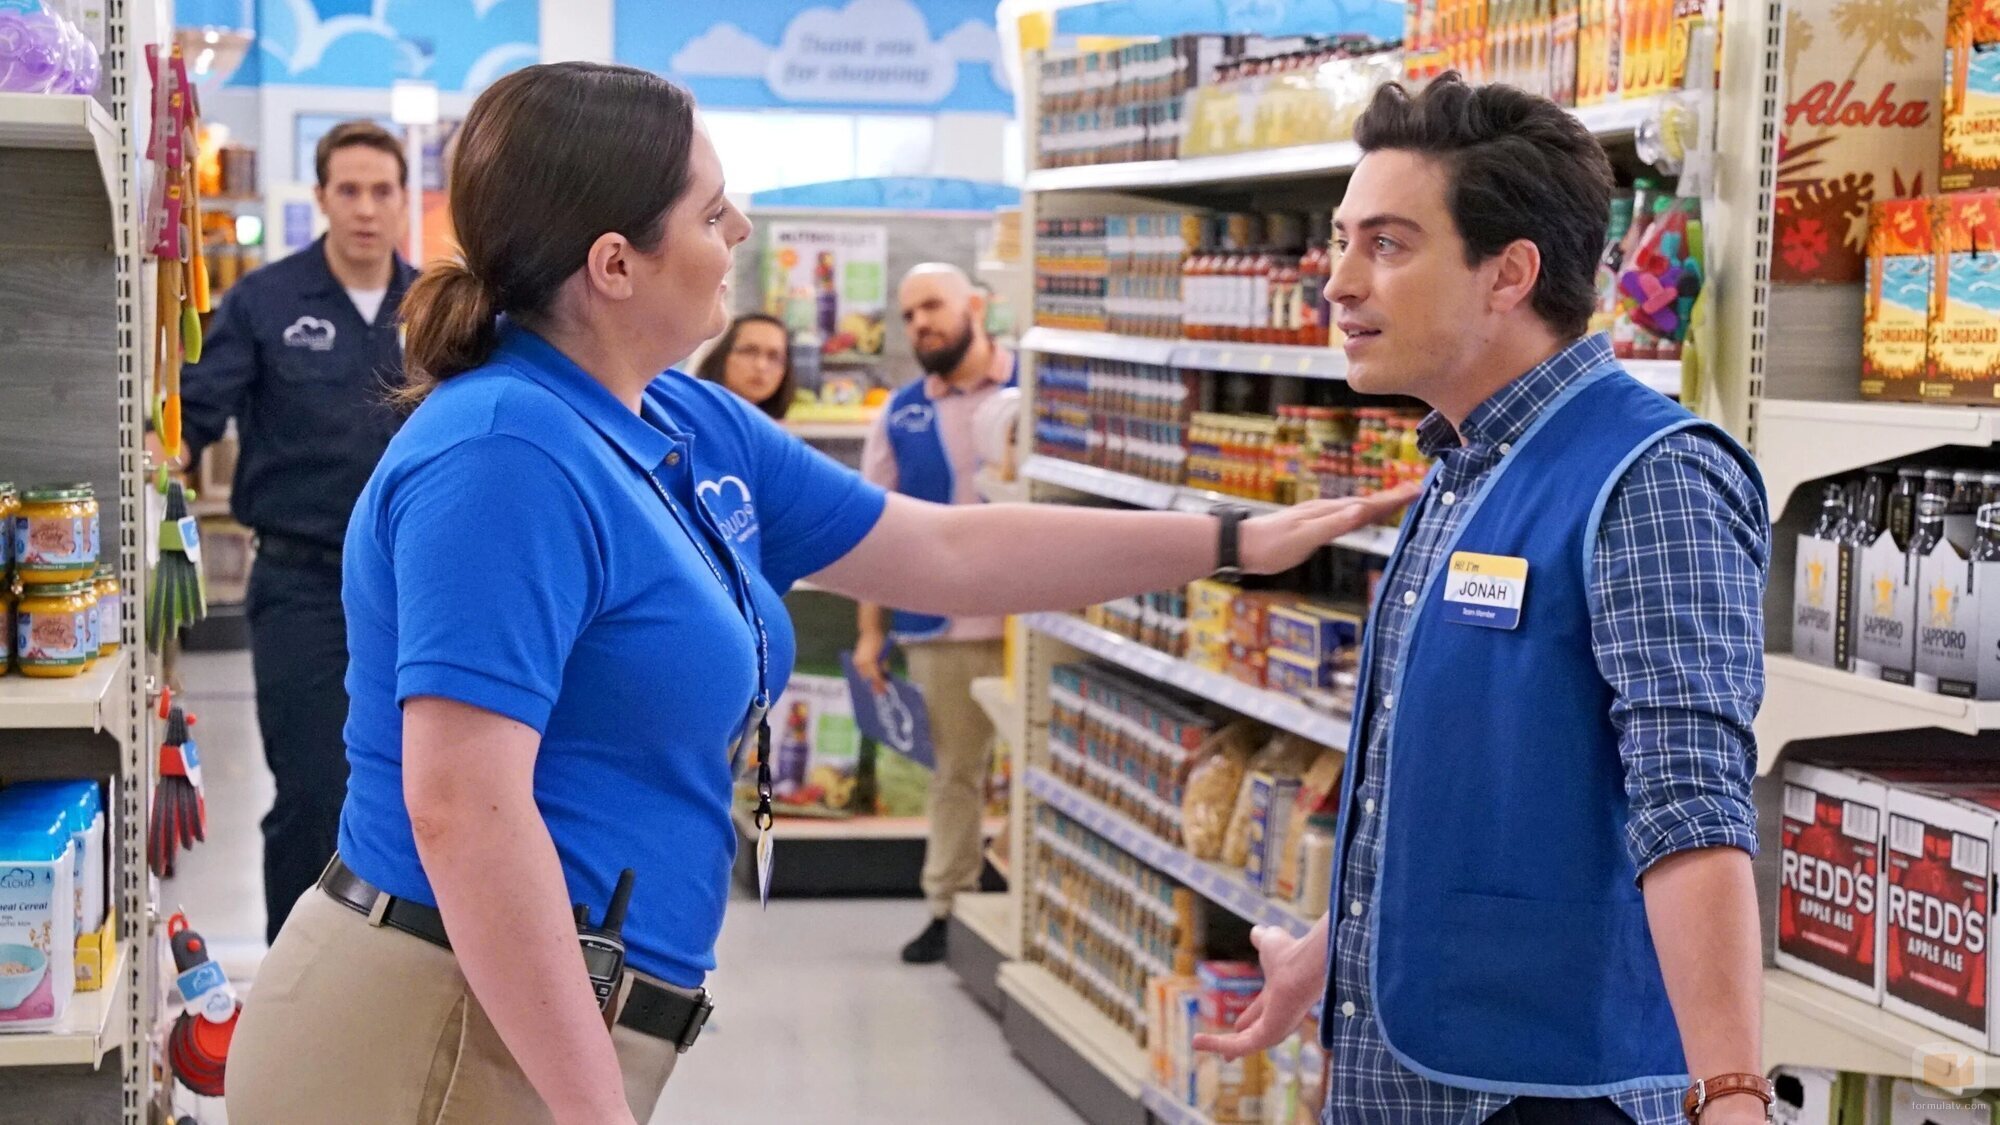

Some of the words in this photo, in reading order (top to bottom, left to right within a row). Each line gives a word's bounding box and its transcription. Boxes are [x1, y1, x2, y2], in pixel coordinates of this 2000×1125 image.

[1785, 79, 1931, 127] Aloha
[1941, 328, 1997, 343] LONGBOARD
[1459, 581, 1507, 601] JONAH
[1864, 614, 1904, 640] SAPPORO
[1922, 626, 1966, 650] SAPPORO
[1781, 848, 1875, 915] REDD'S
[19, 901, 48, 911] Cereal
[1799, 898, 1832, 924] APPLE
[1833, 910, 1854, 932] ALE
[1889, 884, 1985, 954] REDD'S
[1907, 936, 1941, 964] APPLE
[1942, 950, 1963, 972] ALE
